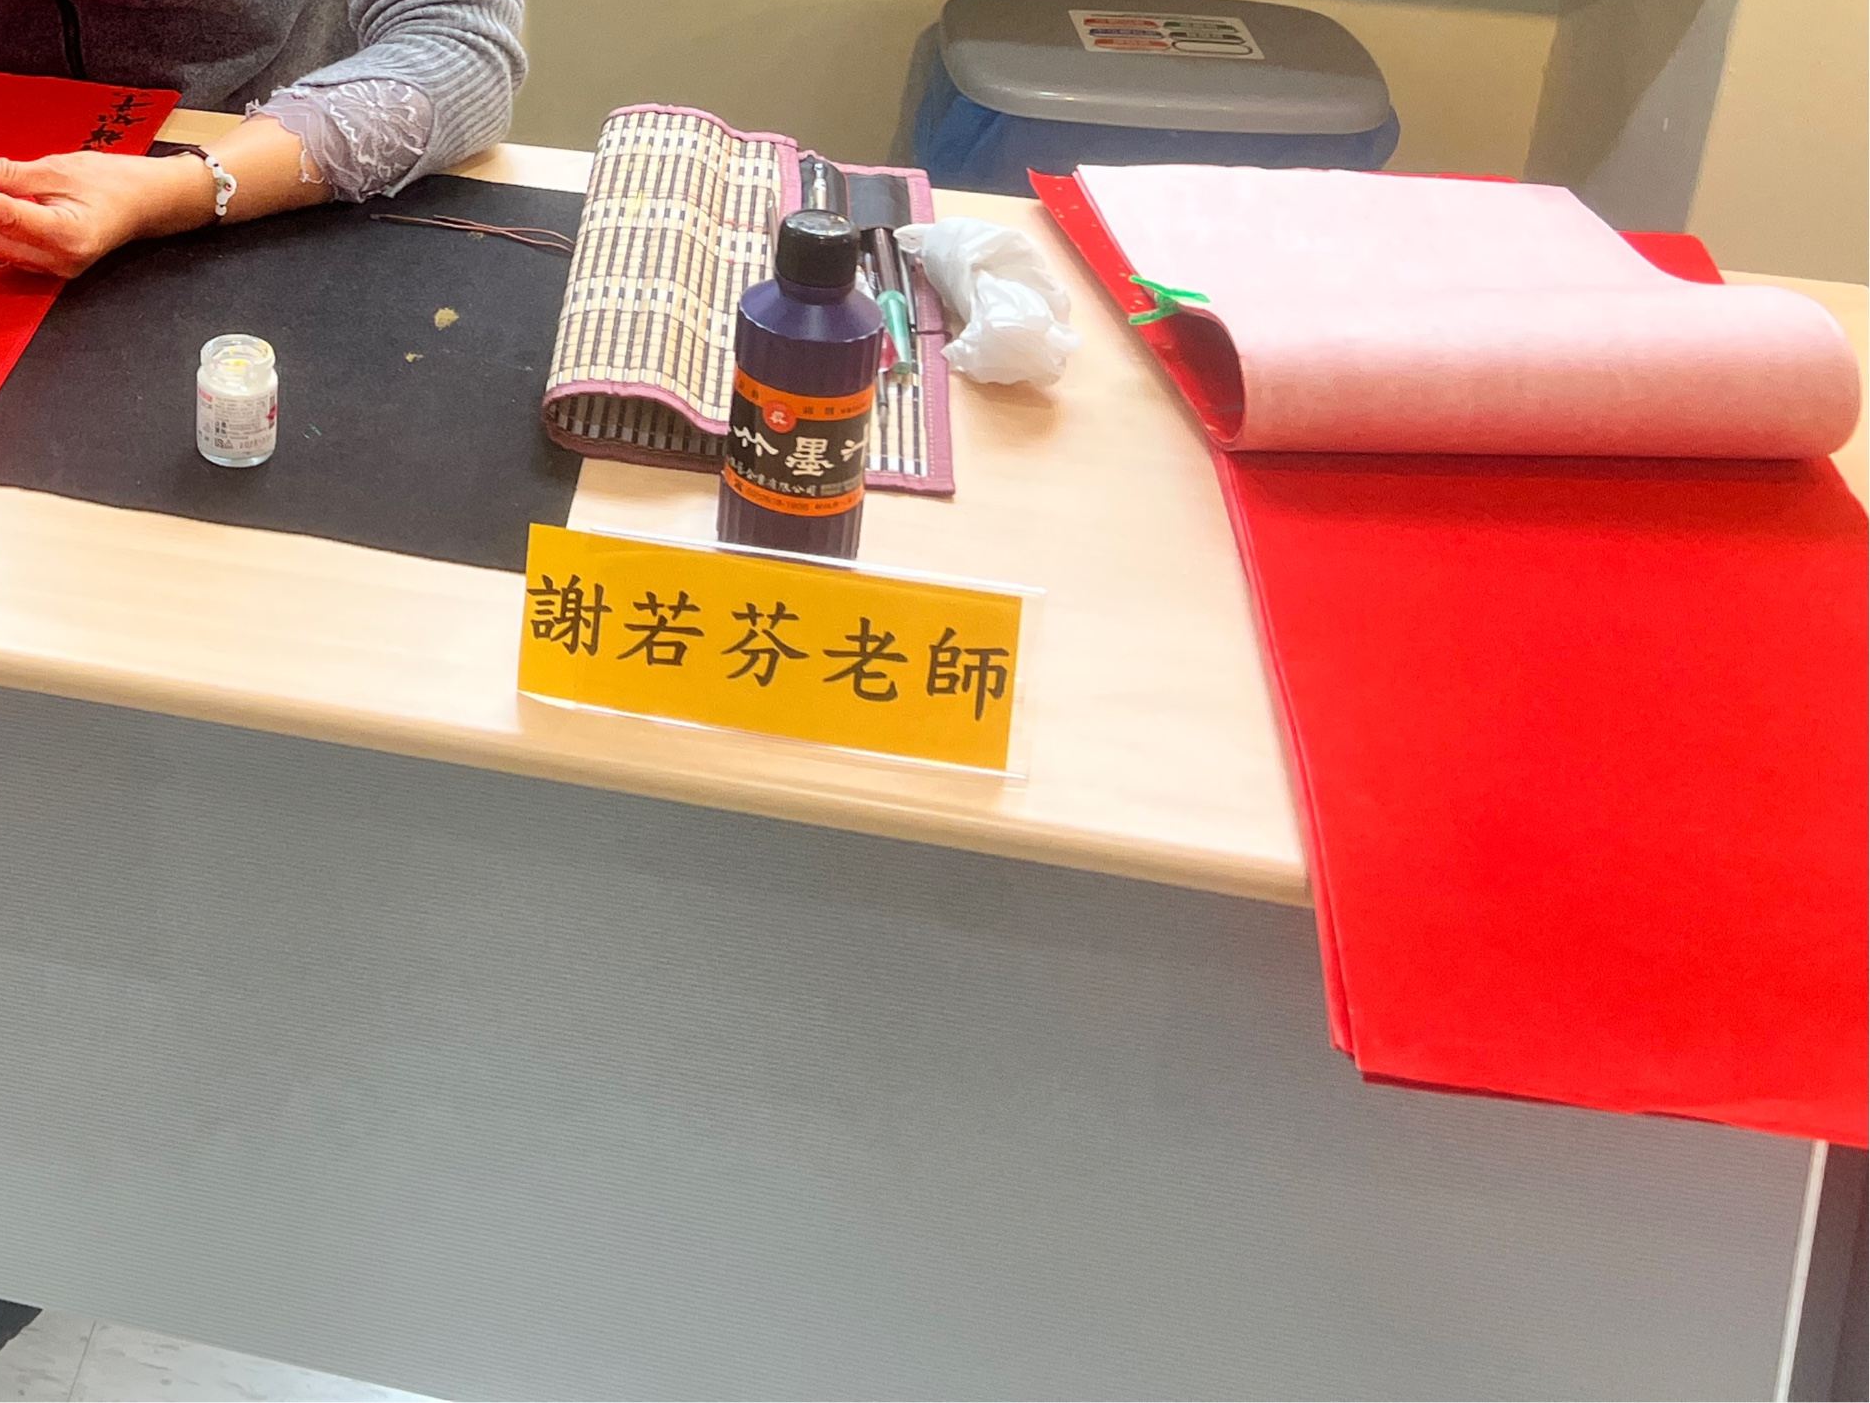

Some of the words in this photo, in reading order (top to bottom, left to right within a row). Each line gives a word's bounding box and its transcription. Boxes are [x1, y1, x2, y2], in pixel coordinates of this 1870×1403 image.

[527, 574, 1008, 721] 謝若芬老師
